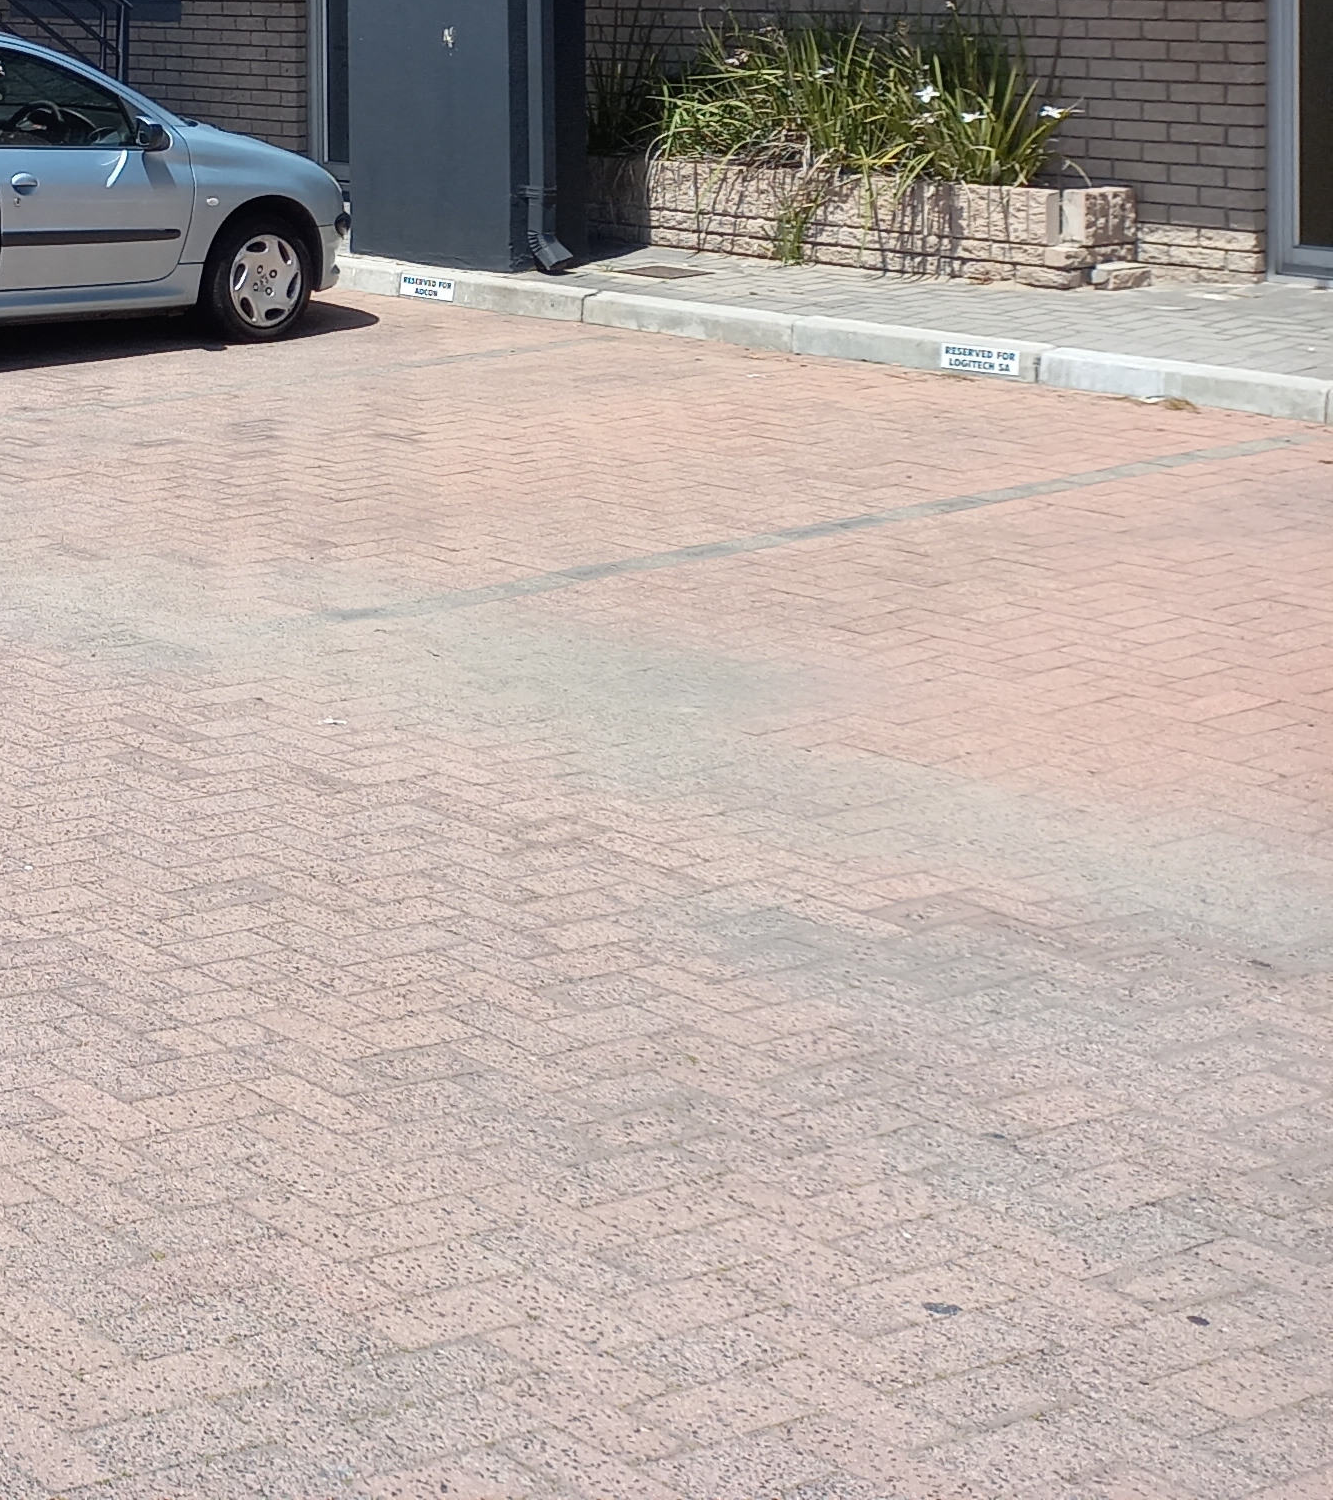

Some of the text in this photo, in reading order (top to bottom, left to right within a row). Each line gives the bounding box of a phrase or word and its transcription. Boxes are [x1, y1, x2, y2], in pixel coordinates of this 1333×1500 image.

[438, 281, 452, 289] FOR
[945, 346, 1016, 361] RESERVED FOR
[948, 358, 1011, 372] LOGITECH SA
